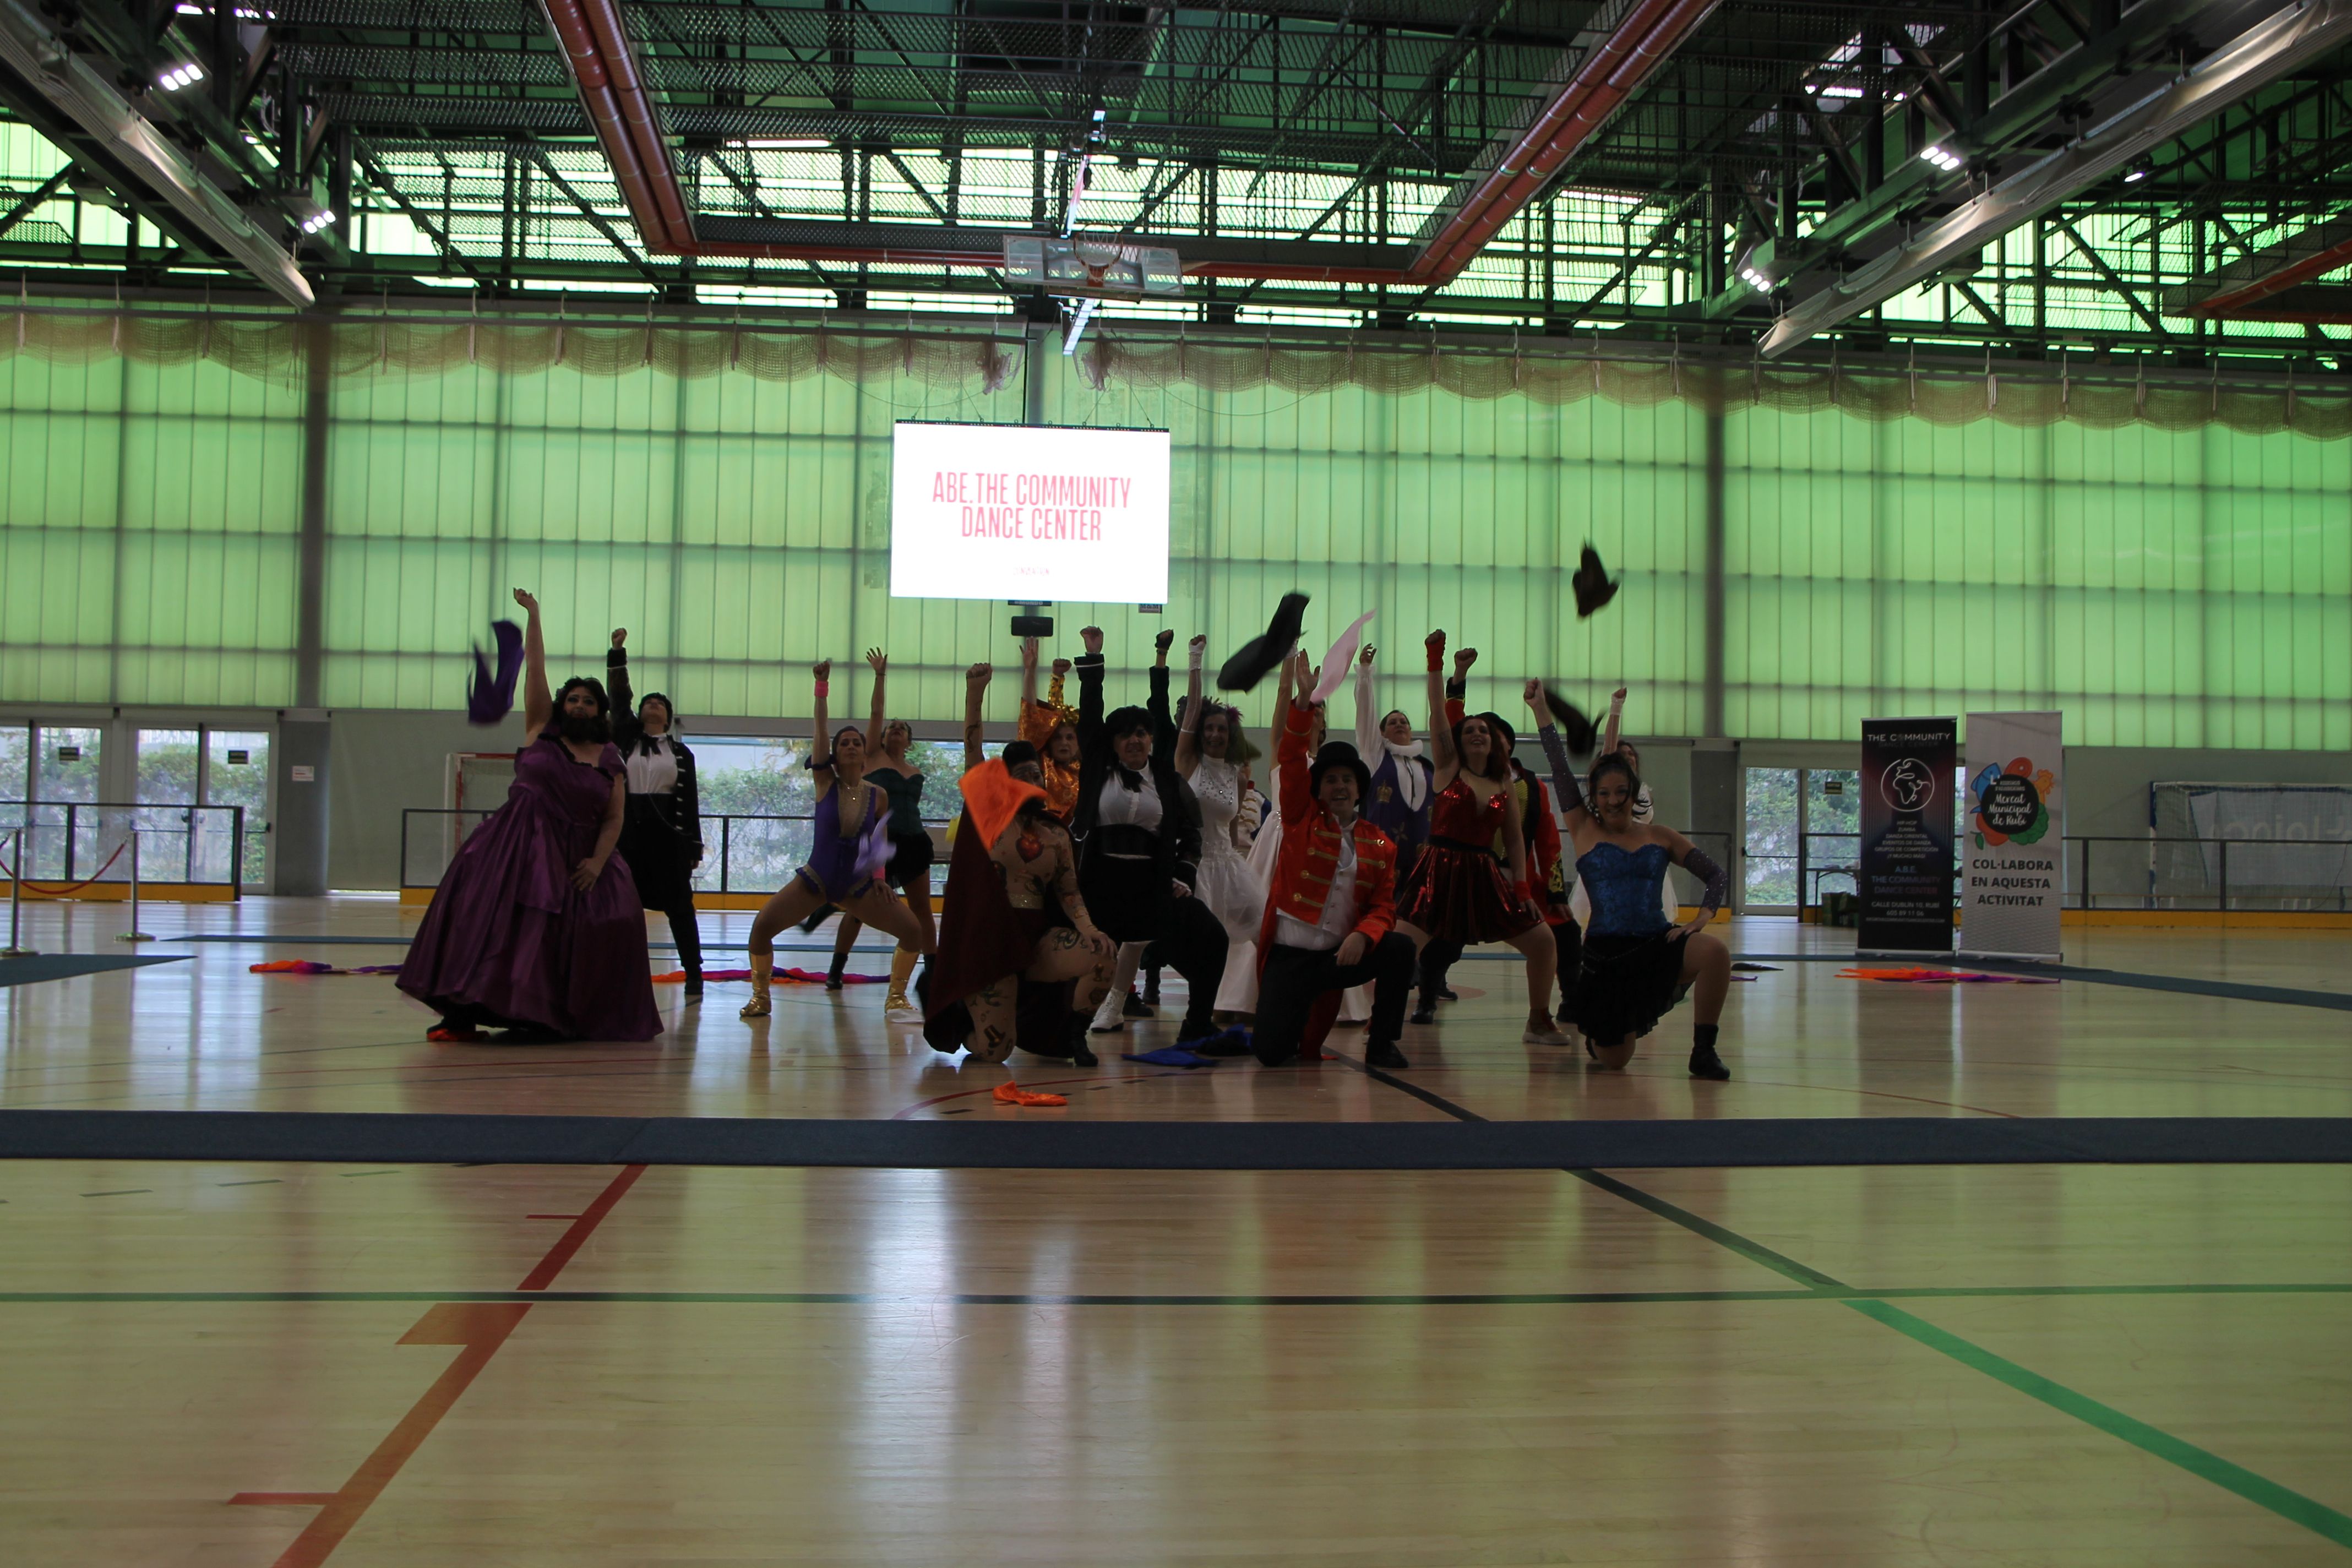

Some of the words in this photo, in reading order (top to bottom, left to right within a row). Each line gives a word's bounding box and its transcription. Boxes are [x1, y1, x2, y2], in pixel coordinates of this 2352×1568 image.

[933, 472, 1008, 504] ABE.THE
[1016, 474, 1131, 508] COMMUNITY
[962, 507, 1023, 538] DANCE
[1031, 508, 1101, 541] CENTER
[1994, 793, 2026, 804] Mercat
[1988, 802, 2033, 816] Municipal
[1992, 813, 2004, 826] de
[1972, 876, 1989, 887] EN
[1991, 876, 2051, 889] AQUESTA
[1978, 895, 2044, 906] ACTIVITAT
